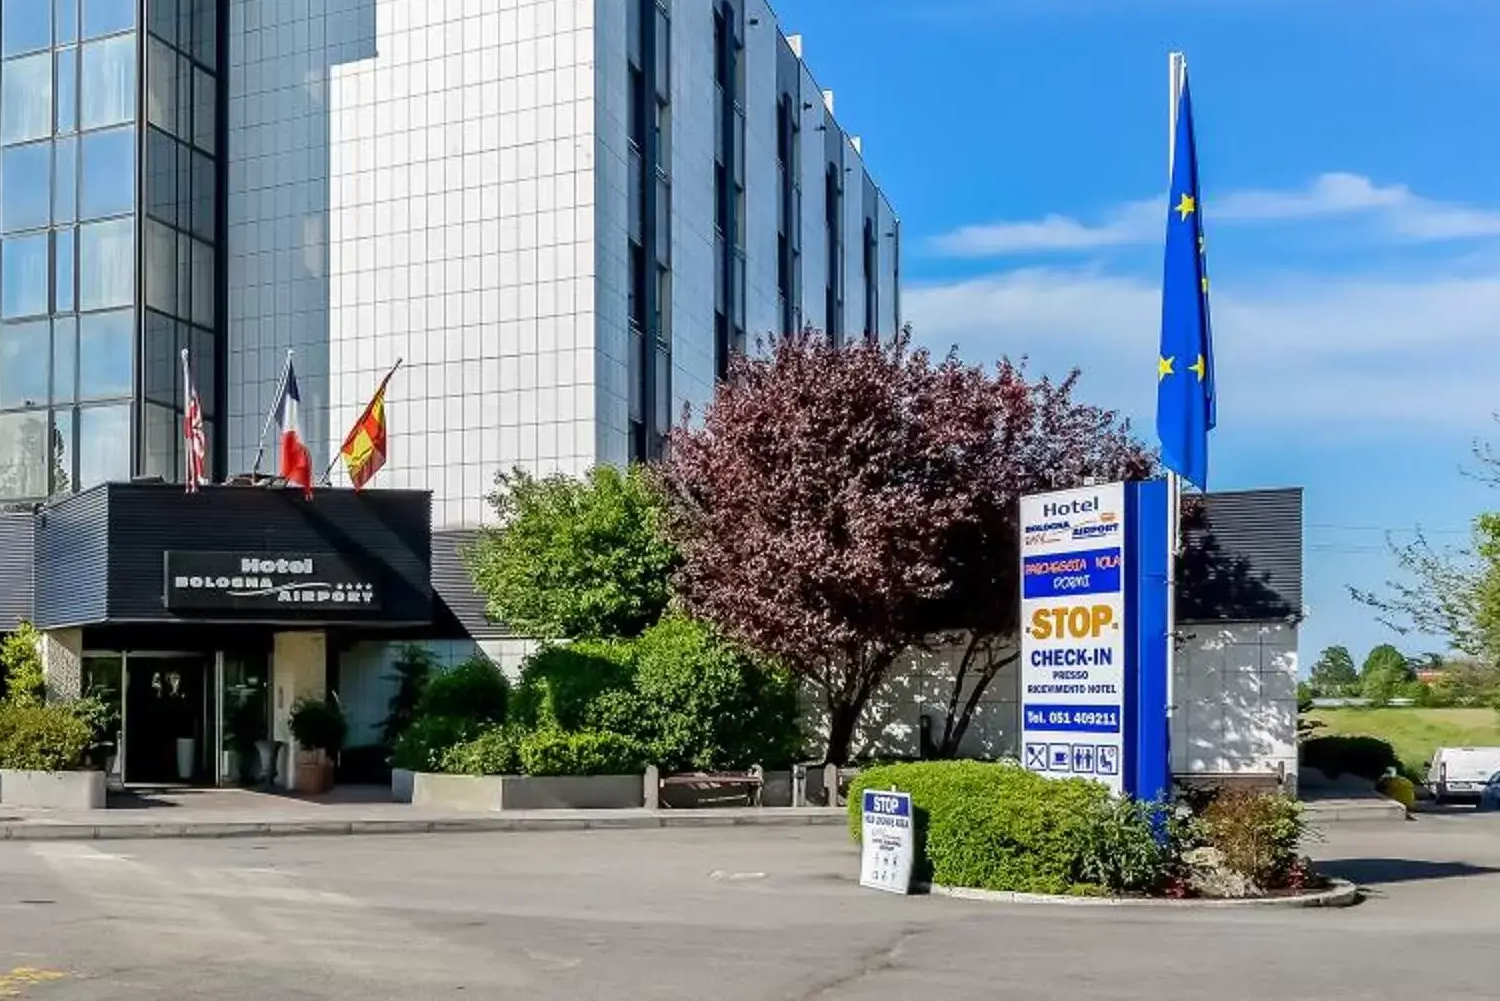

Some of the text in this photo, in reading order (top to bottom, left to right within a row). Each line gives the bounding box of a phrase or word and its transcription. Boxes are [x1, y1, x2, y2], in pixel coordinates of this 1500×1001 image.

[1043, 496, 1099, 517] Hotel
[1025, 521, 1119, 535] BOLOGNA AIRPORT
[241, 558, 313, 574] Hotel
[175, 576, 373, 603] BOLOGNA AIRPORT
[1031, 604, 1113, 639] STOP
[1031, 647, 1112, 667] CHECK-IN
[1052, 670, 1089, 680] PRESSO
[1088, 684, 1117, 694] HOTEL
[1027, 710, 1047, 724] Tel.
[1049, 711, 1071, 724] 051
[873, 796, 899, 813] STOP
